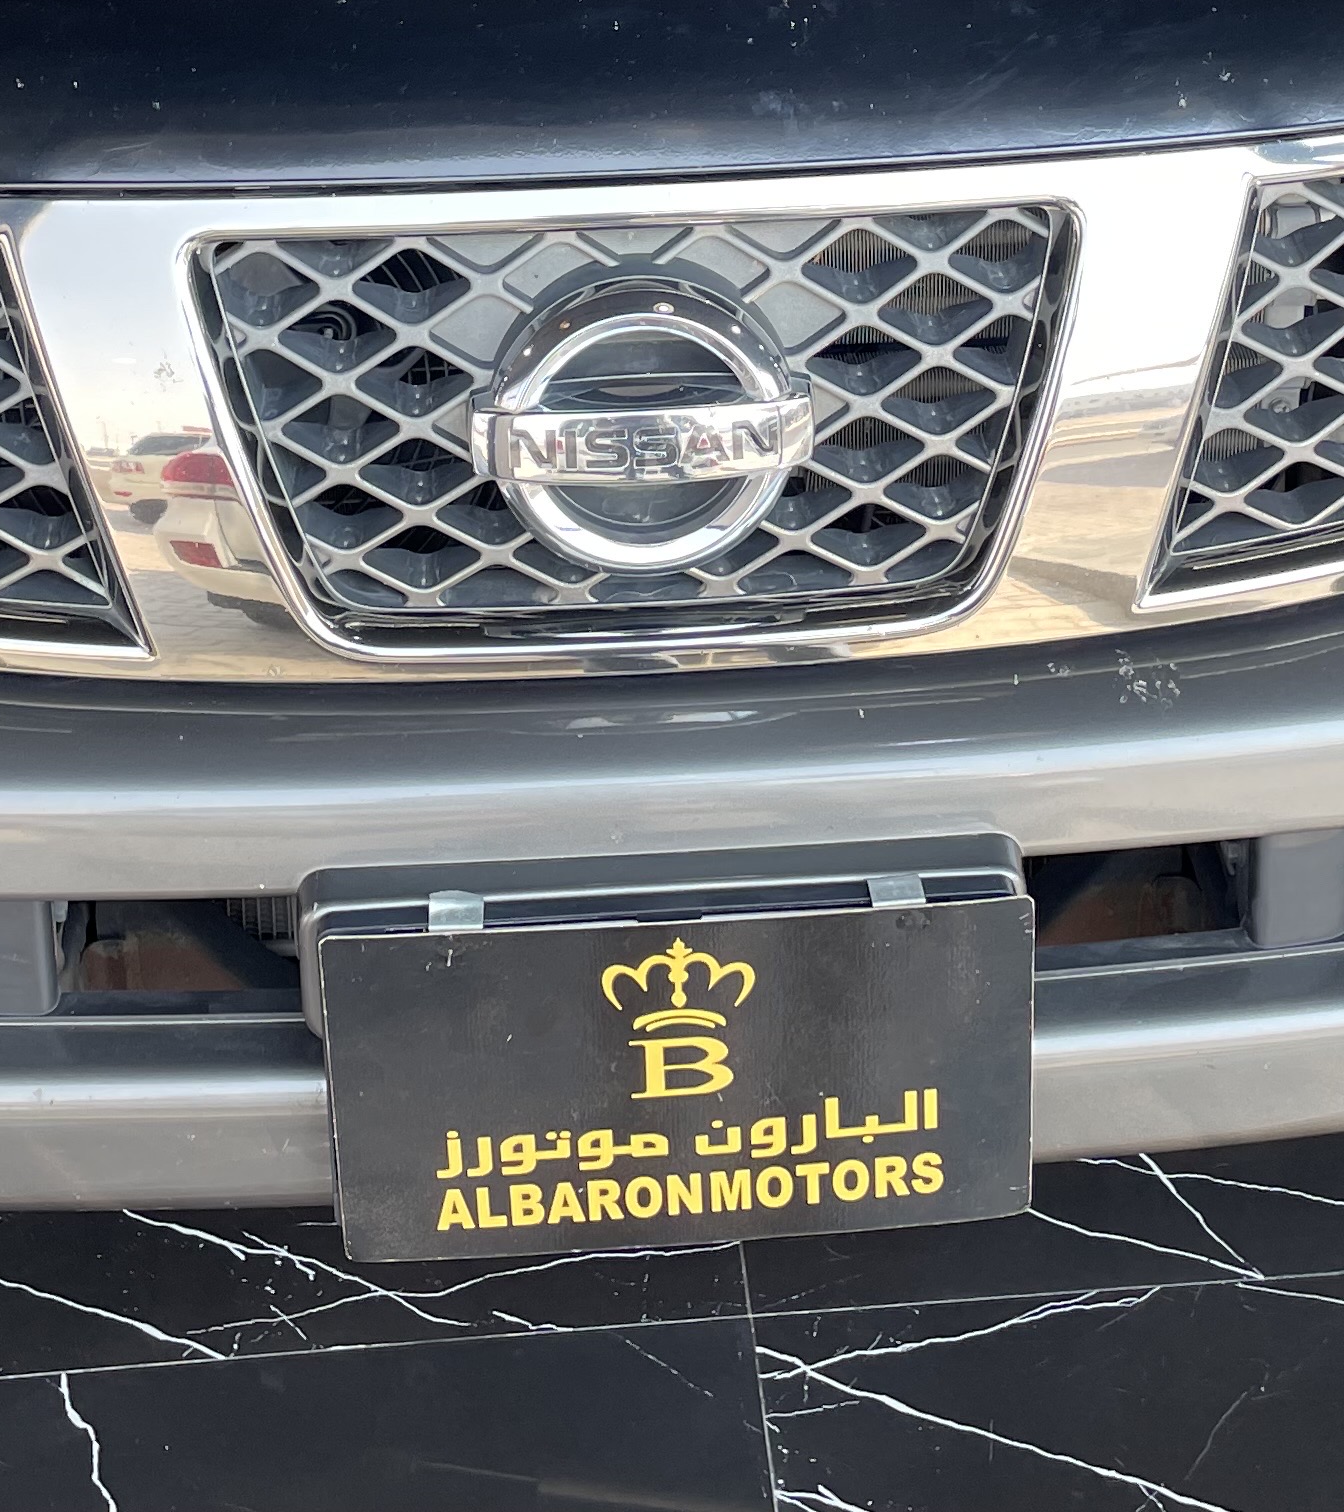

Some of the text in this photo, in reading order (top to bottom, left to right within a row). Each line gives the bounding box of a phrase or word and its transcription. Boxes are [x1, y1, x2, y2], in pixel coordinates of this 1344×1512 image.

[508, 419, 780, 471] NISSAN
[628, 1035, 735, 1100] B
[435, 1087, 940, 1180] البارون موتورز
